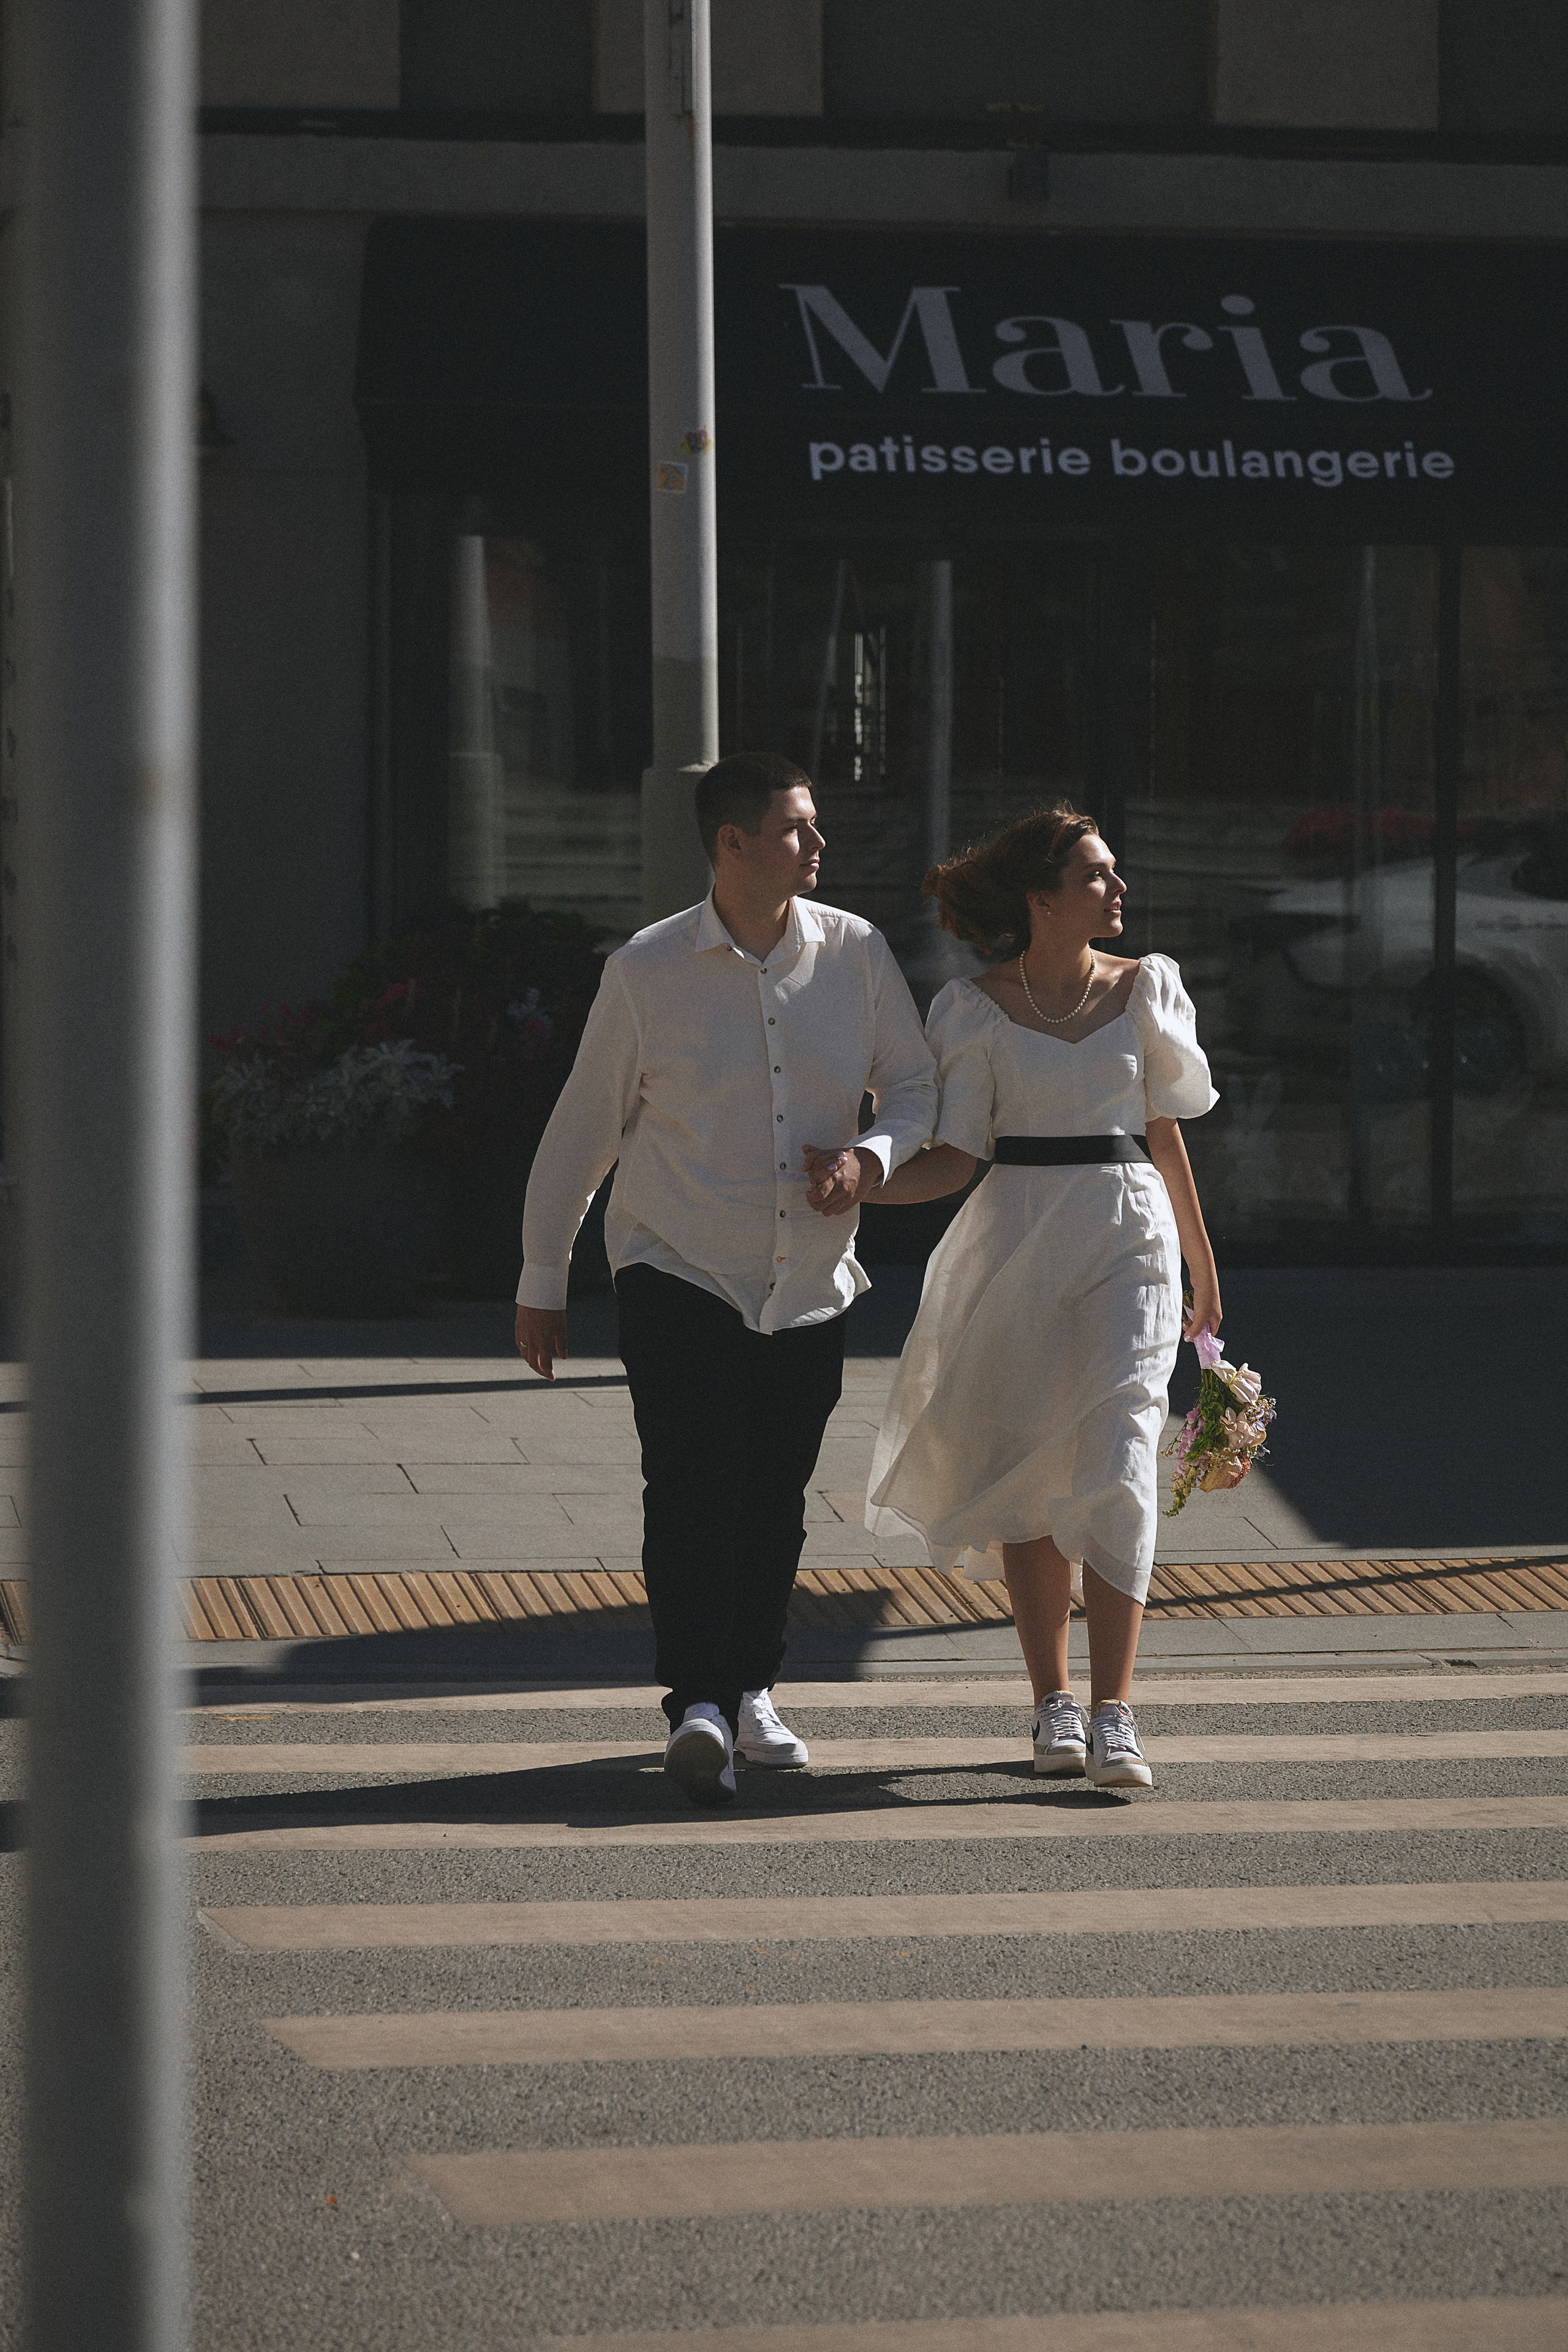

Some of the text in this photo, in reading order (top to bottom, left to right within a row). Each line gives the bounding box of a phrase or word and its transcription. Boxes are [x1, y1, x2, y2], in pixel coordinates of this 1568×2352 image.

[778, 284, 1433, 402] Maria
[809, 435, 1455, 487] patisserie boulangerie
